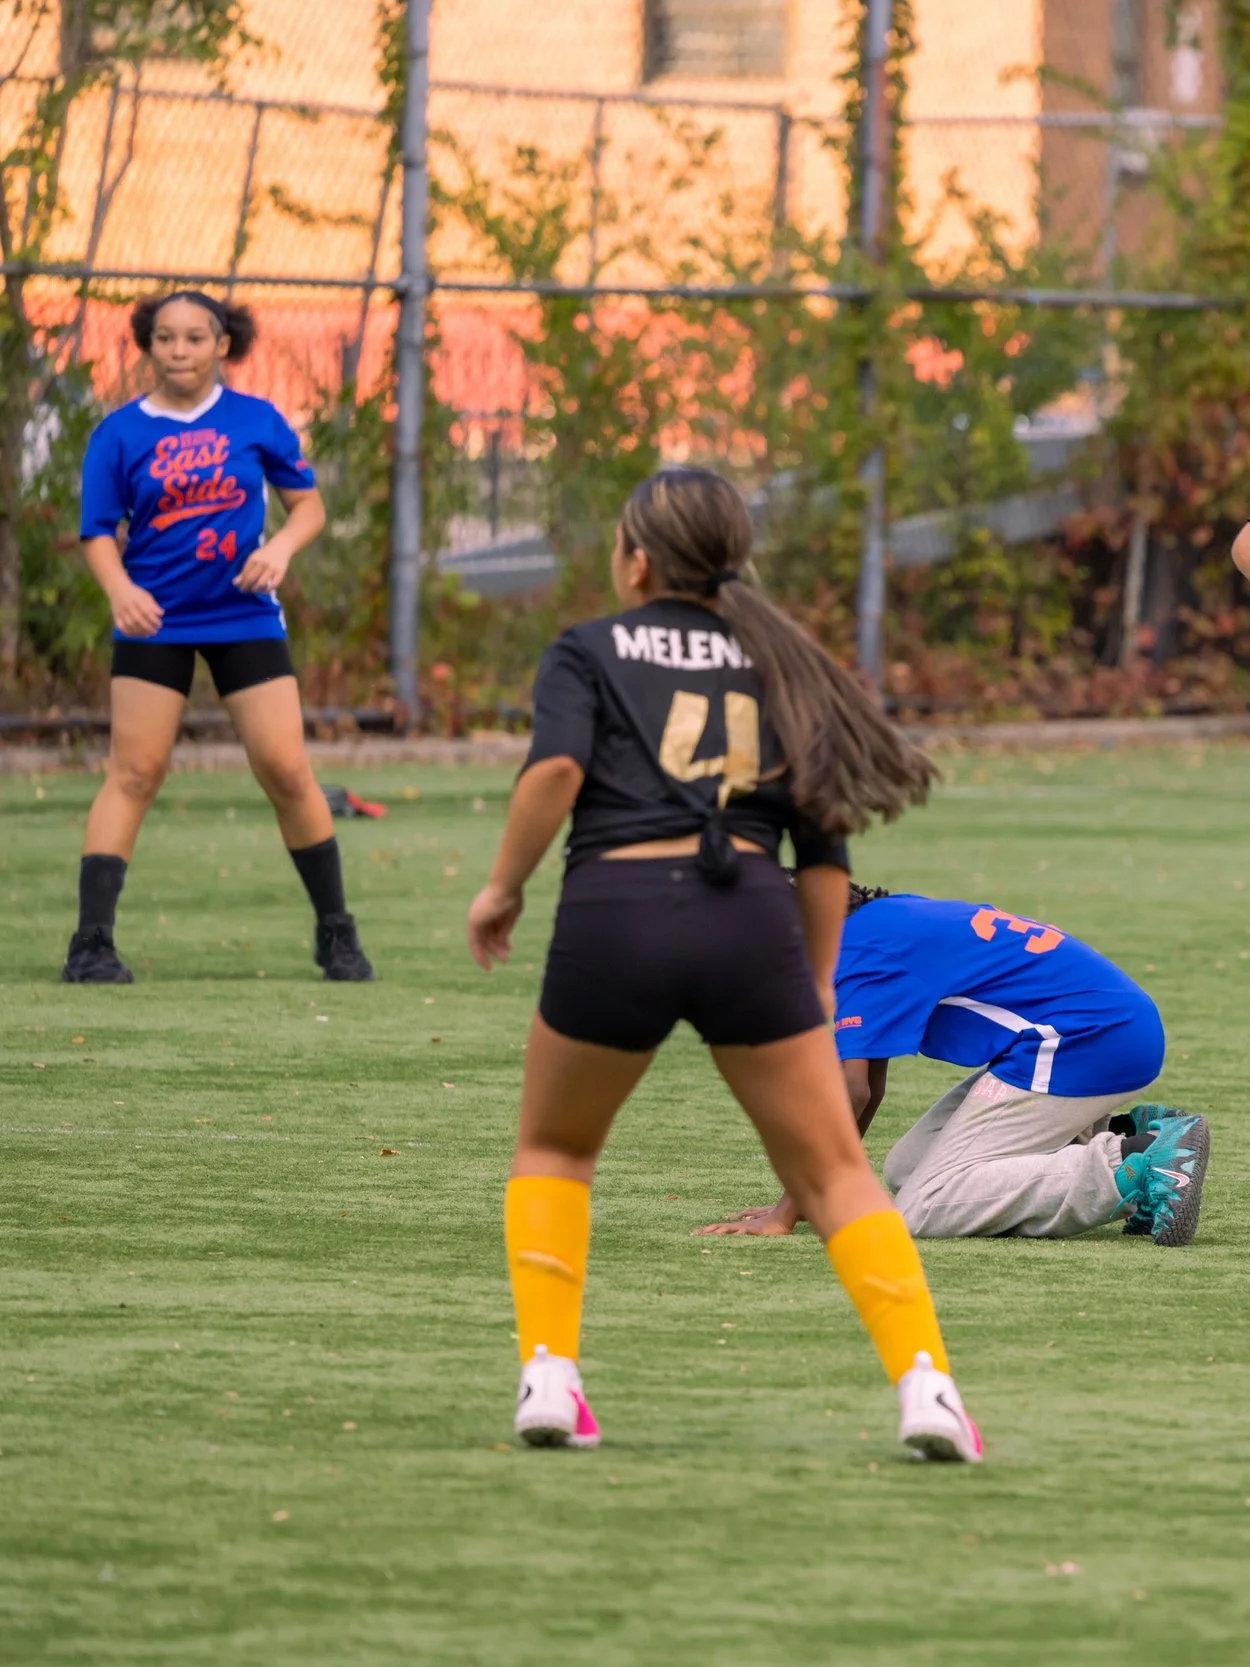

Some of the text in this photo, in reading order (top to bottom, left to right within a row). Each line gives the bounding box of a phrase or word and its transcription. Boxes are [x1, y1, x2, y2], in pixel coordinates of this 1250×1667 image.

[150, 434, 230, 478] East
[157, 466, 242, 512] Side
[196, 528, 237, 561] 24
[611, 623, 754, 671] MELEN
[658, 690, 760, 810] 4
